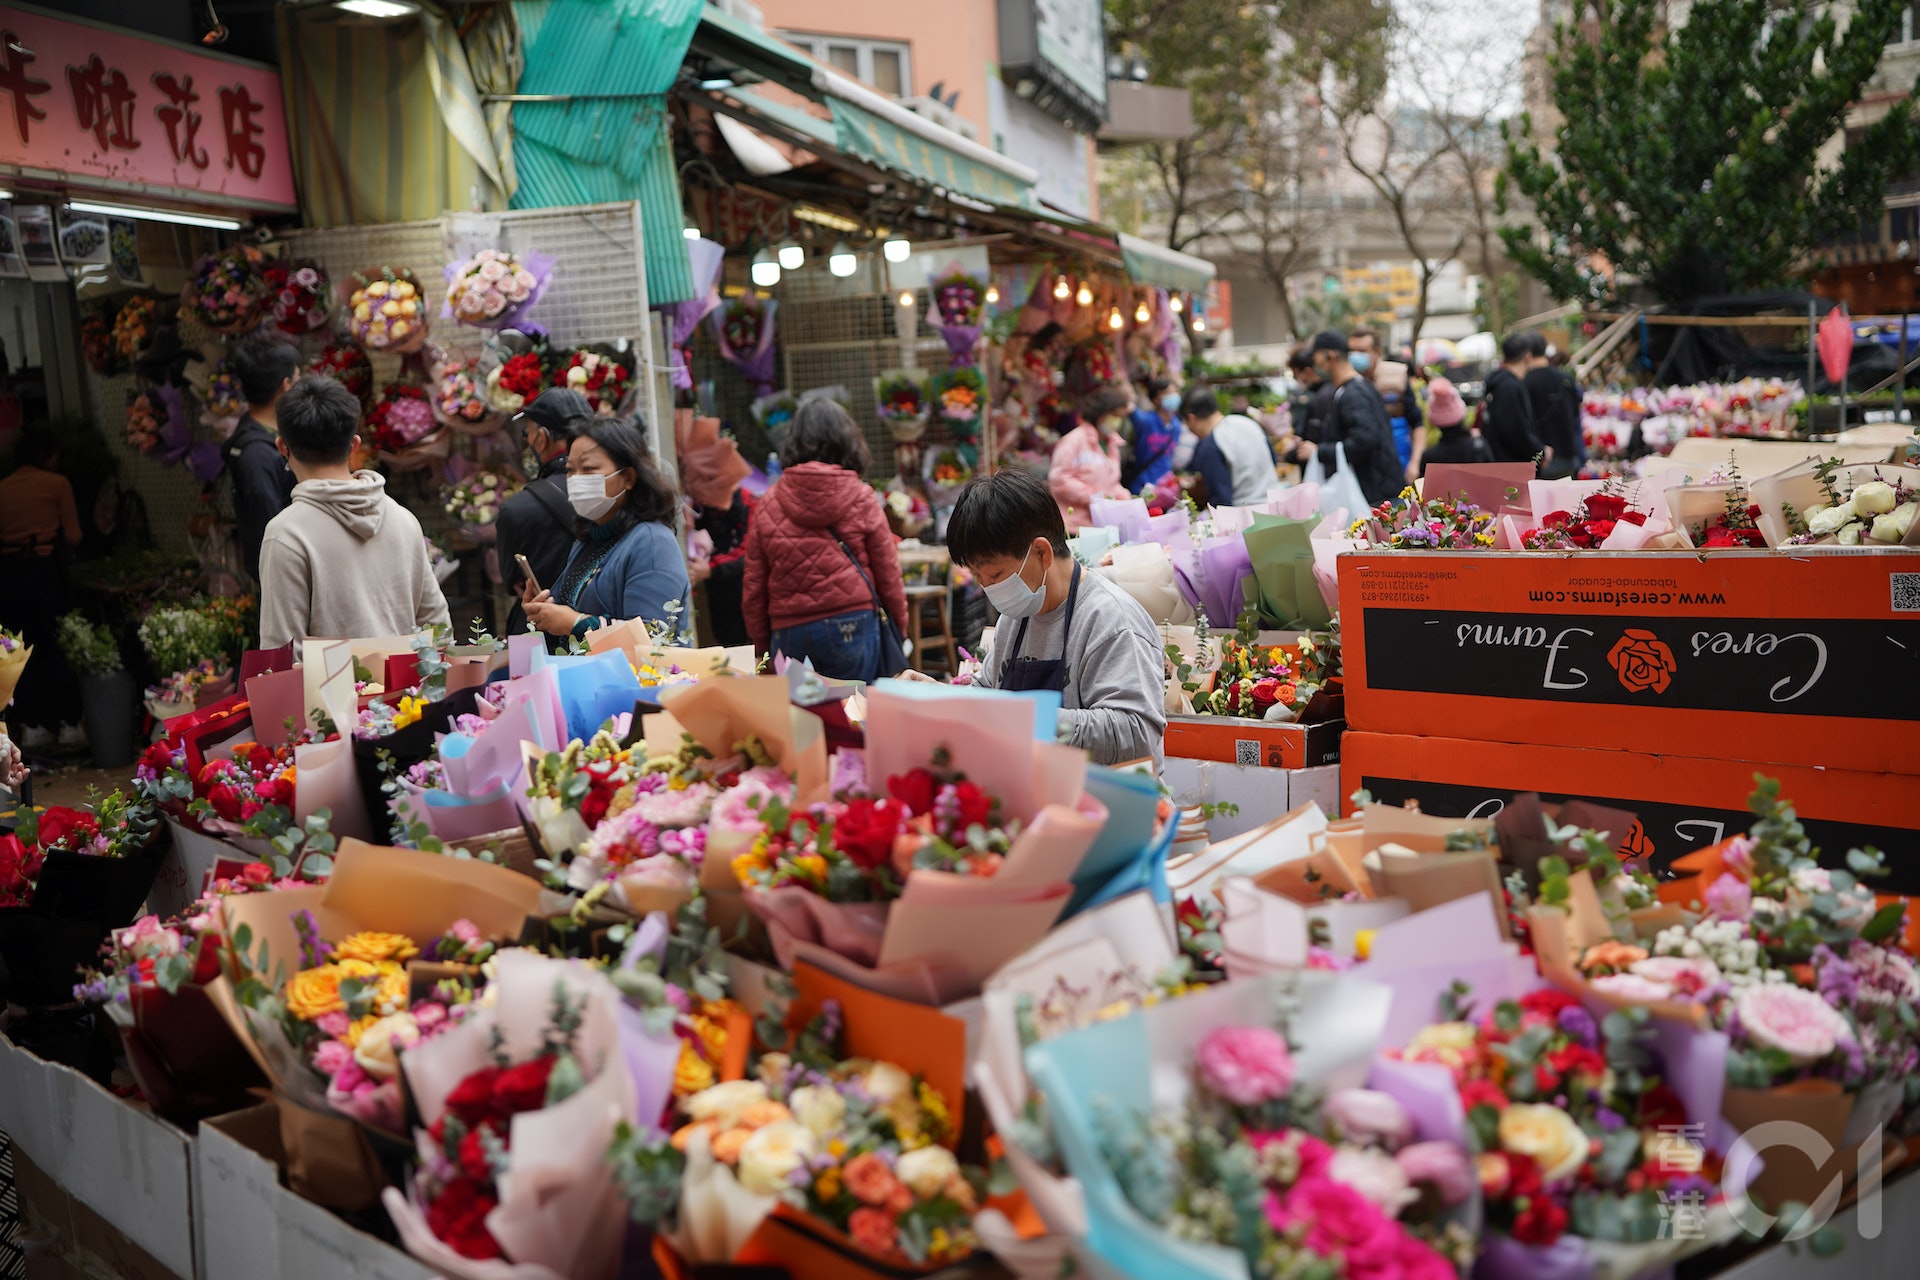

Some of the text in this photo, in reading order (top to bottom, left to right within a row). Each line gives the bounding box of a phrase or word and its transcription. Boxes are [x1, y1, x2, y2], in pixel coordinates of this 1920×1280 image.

[0, 30, 265, 179] 卡啦花店
[1360, 571, 1457, 580] sales@ceresfarms.com
[1568, 577, 1678, 588] Tabacundo-Ecuador
[1362, 591, 1431, 602] +593(2)2362-873
[1528, 590, 1726, 606] www.ceresfarms.com
[1456, 622, 1828, 703] Ceres Farms
